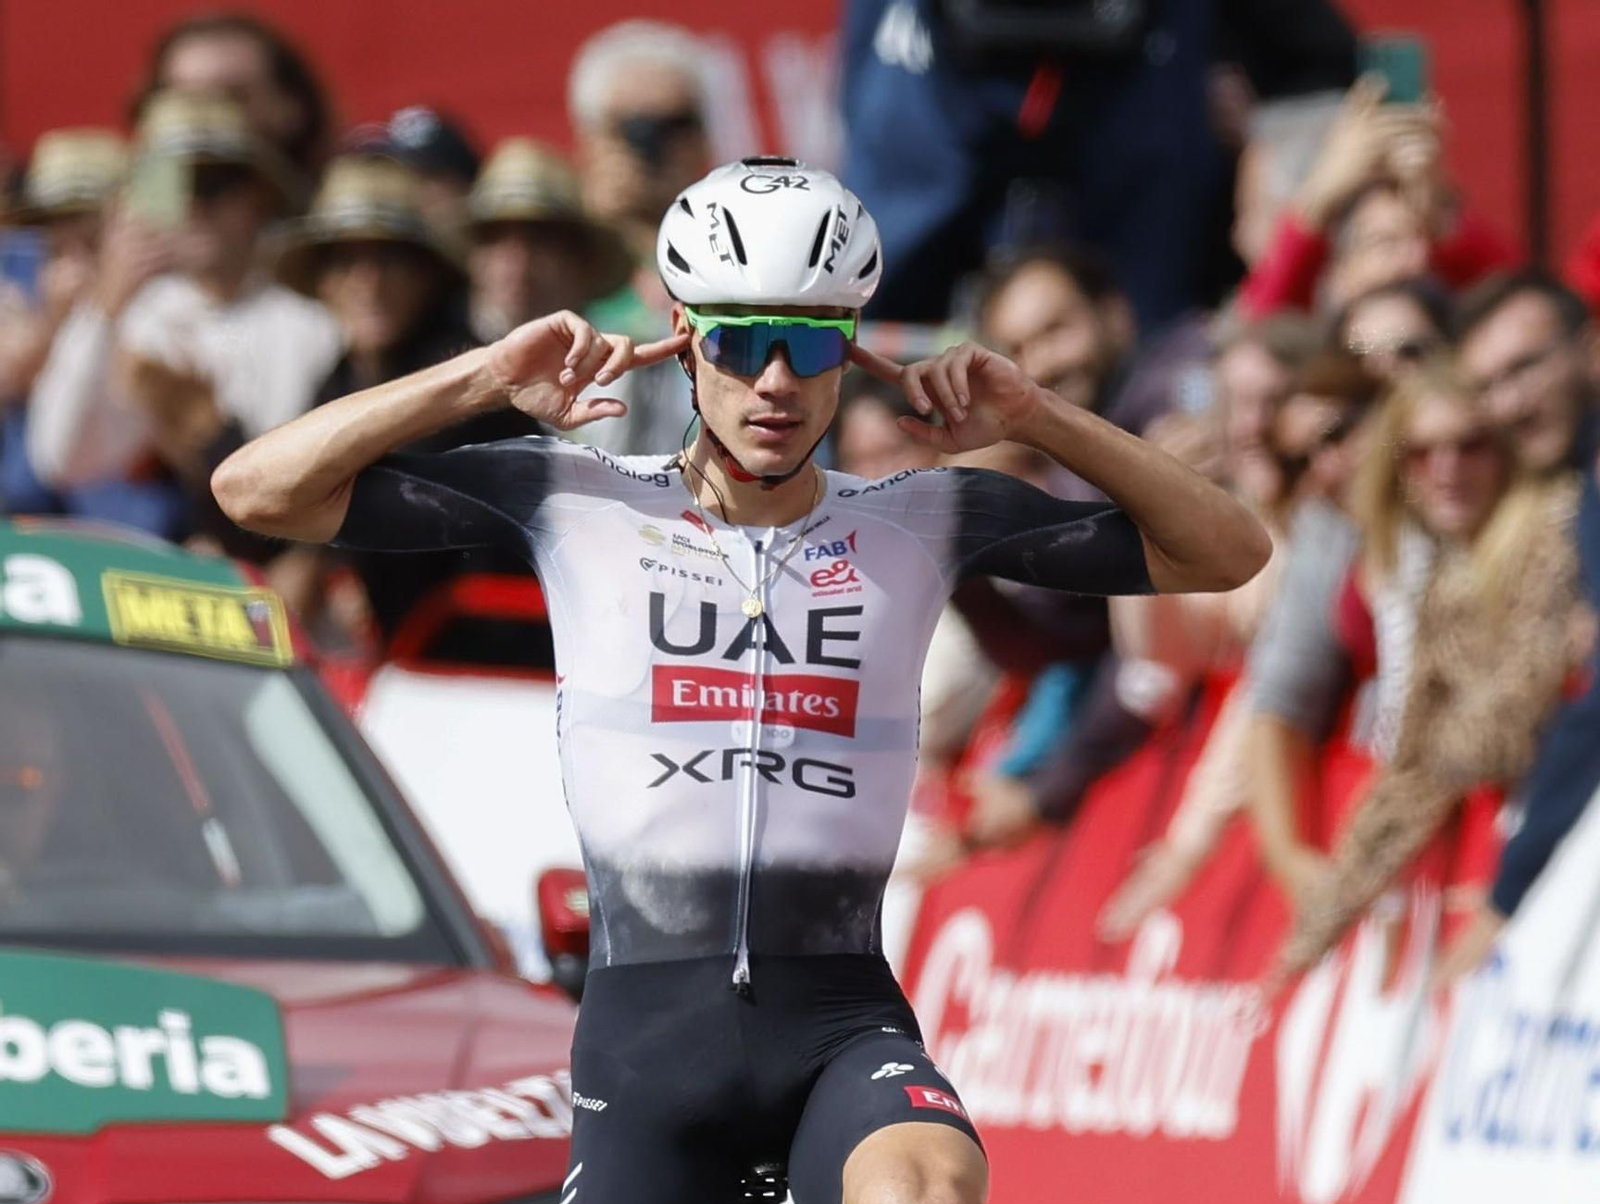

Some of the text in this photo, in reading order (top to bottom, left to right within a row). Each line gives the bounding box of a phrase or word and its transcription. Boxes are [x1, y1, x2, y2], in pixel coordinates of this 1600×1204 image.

[740, 174, 811, 194] G42
[706, 202, 735, 267] MET
[823, 204, 850, 274] MET
[582, 445, 671, 488] Analog
[658, 563, 723, 586] PISSEI
[649, 591, 865, 670] UAE
[672, 680, 840, 719] Emirates
[646, 747, 857, 799] XRG
